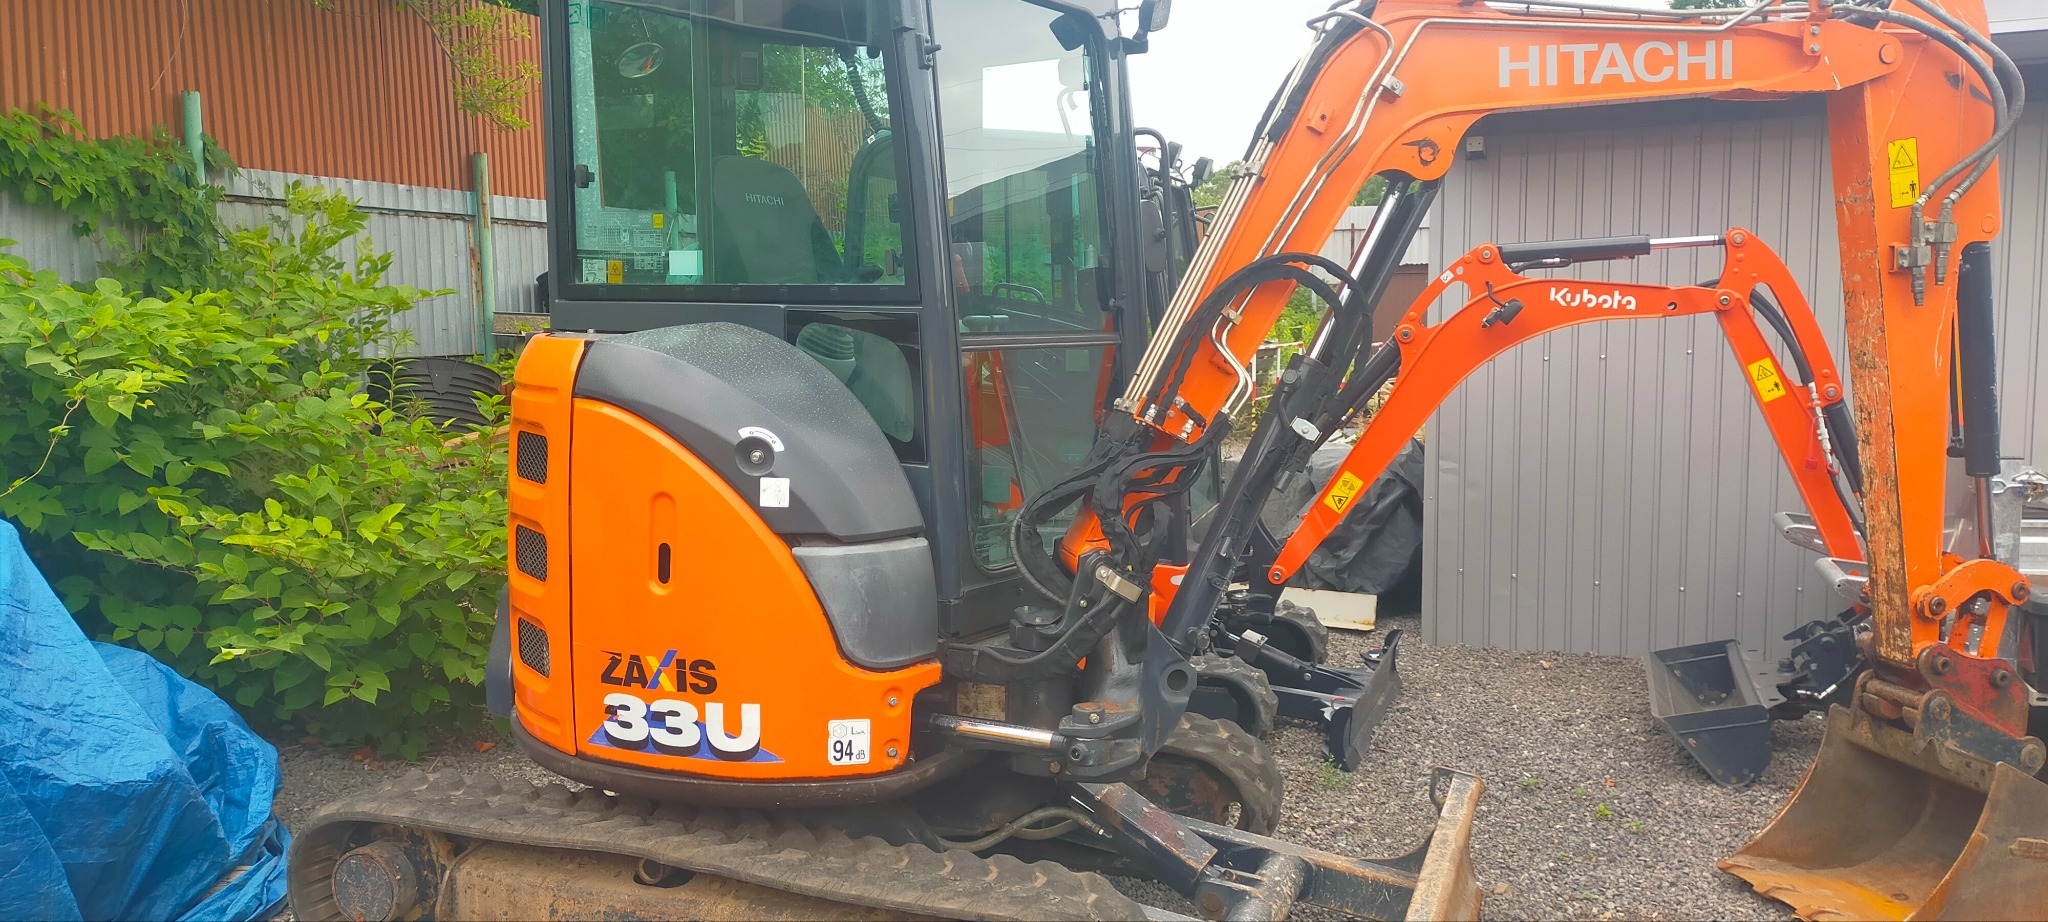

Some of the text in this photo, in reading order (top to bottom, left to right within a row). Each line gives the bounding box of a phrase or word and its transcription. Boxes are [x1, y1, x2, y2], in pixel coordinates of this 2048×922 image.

[1498, 39, 1733, 88] HITACHI
[744, 192, 785, 206] HITACHI
[1549, 287, 1637, 311] Kubota
[600, 649, 718, 695] ZAXIS
[602, 692, 761, 760] 33U
[833, 739, 866, 762] 94 dB
